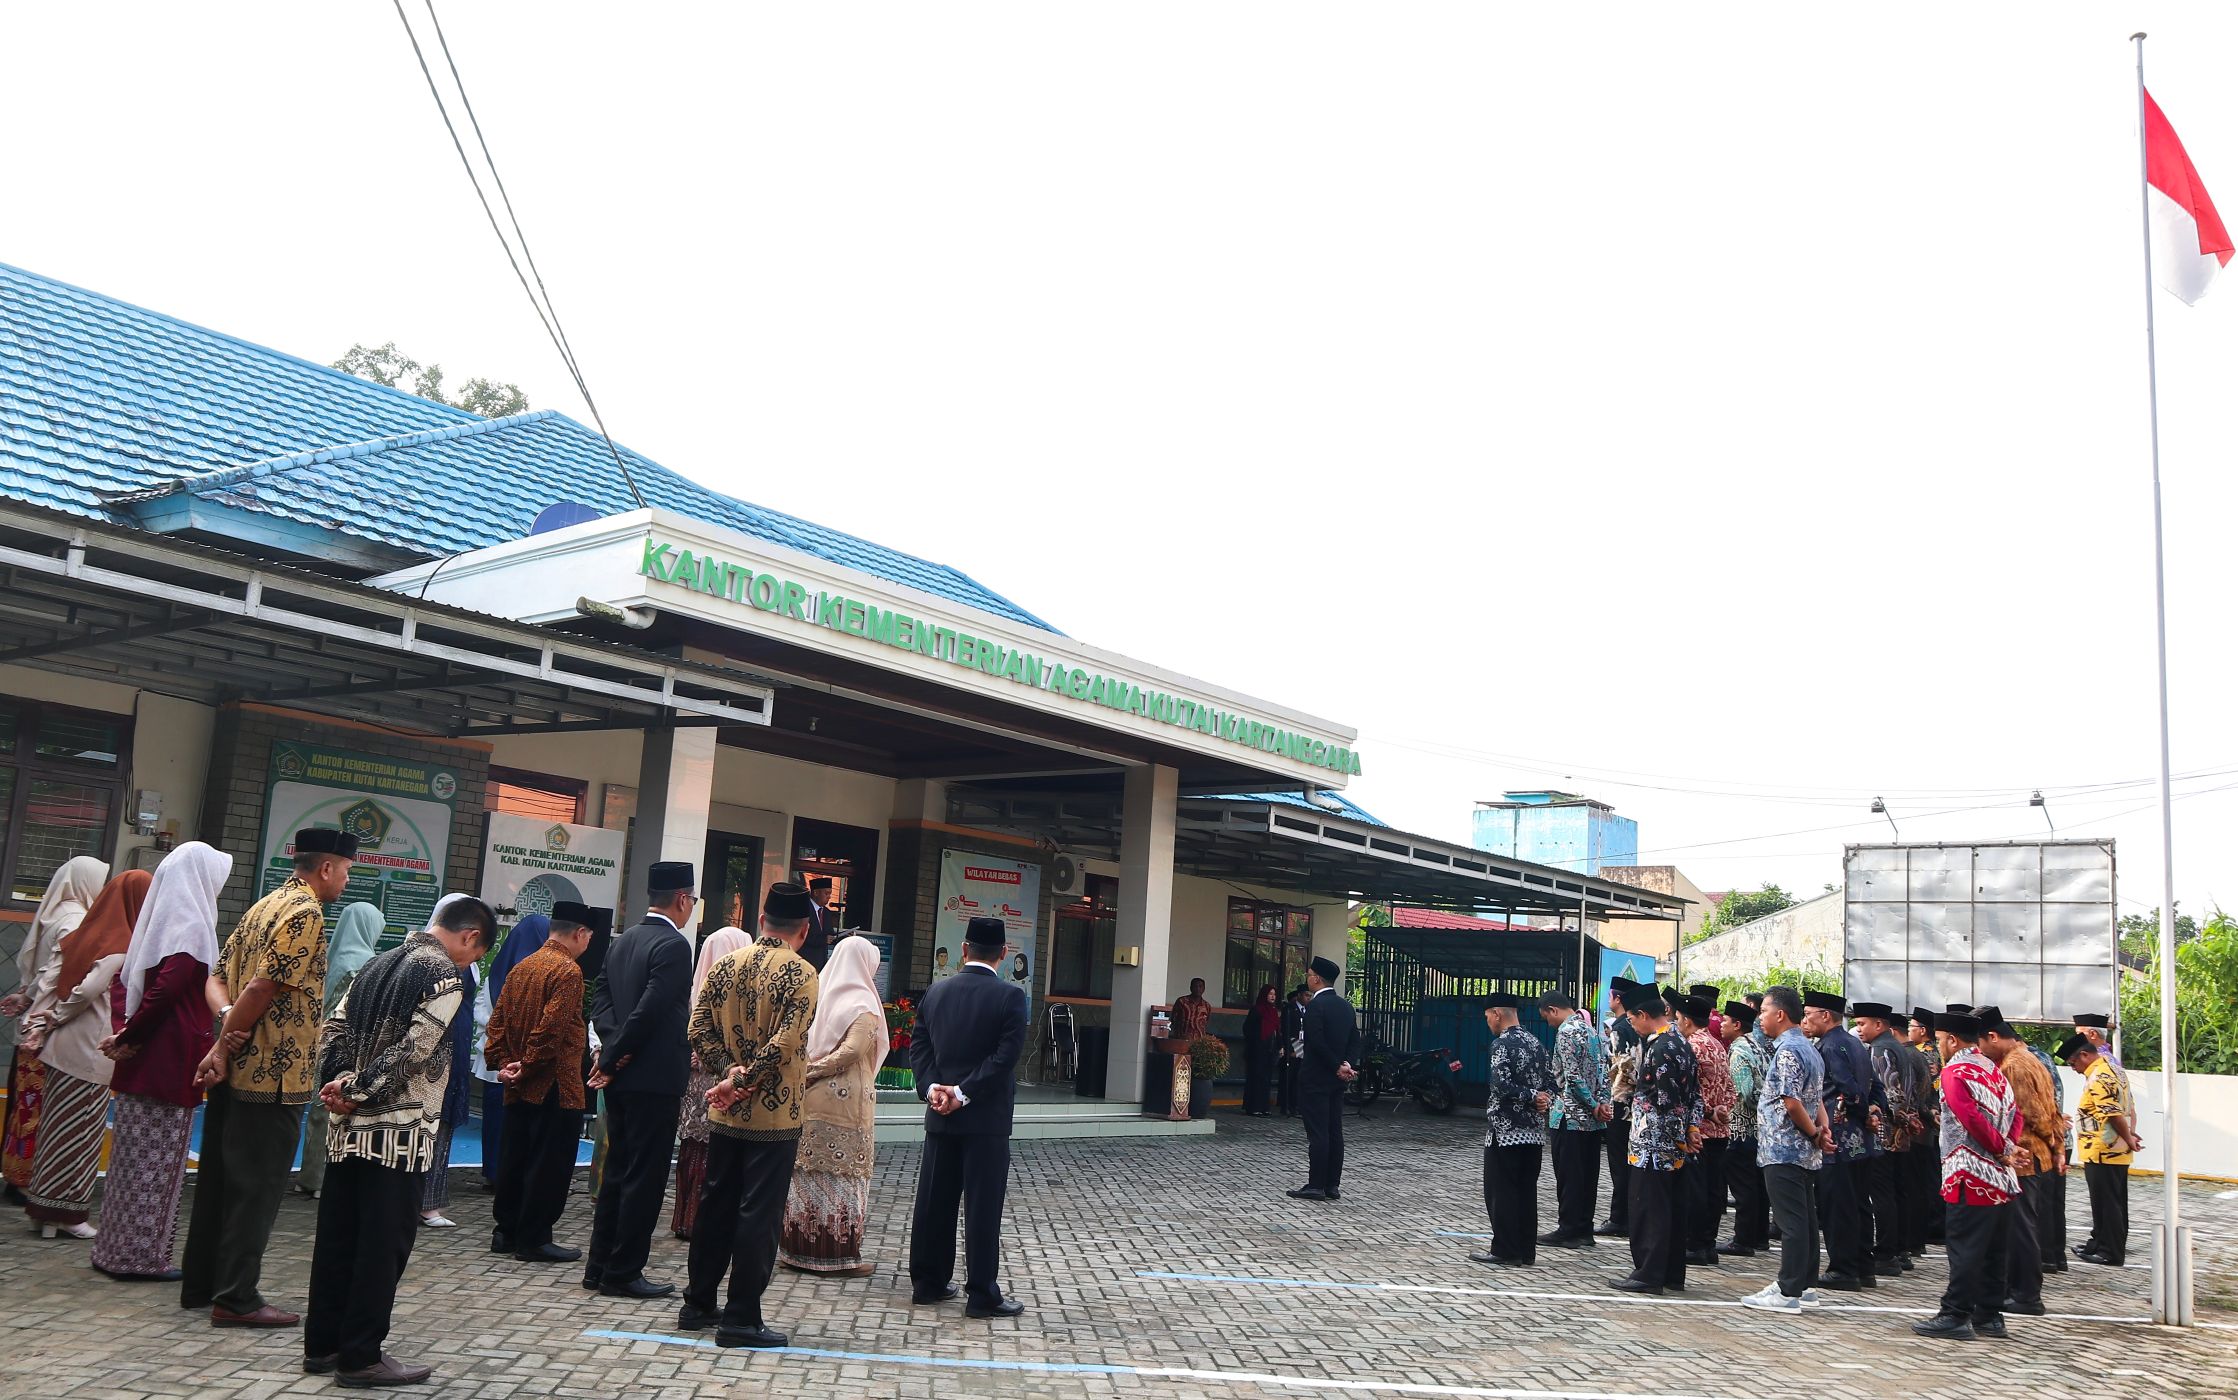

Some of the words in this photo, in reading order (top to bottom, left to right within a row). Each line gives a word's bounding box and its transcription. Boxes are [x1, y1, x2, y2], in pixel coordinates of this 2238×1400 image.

[640, 538, 807, 621] KANTOR
[818, 591, 1043, 688] KEMENTERIAN
[1047, 663, 1145, 716] AGAMA
[1148, 691, 1215, 734] KUTAI
[1218, 712, 1362, 776] KARTANEGARA
[312, 753, 342, 767] KANTOR
[344, 759, 396, 776] KEMENTERIAN
[398, 767, 425, 780] AGAMA
[307, 766, 352, 782] KABUPATEN
[353, 773, 375, 786] KUTAI
[377, 776, 429, 794] KARTANEGARA
[387, 837, 408, 846] KERJA
[359, 853, 405, 868] KEMENTERIAN
[406, 858, 430, 871] AGAMA
[493, 843, 527, 856] KANTOR
[529, 848, 586, 865] KEMENTERIAN
[588, 857, 616, 868] AGAMA
[501, 855, 521, 866] KAB.
[522, 858, 546, 869] KUTAI
[548, 861, 606, 877] KARTANEGARA
[966, 868, 997, 880] WILAYAH
[998, 872, 1018, 881] BEBAS
